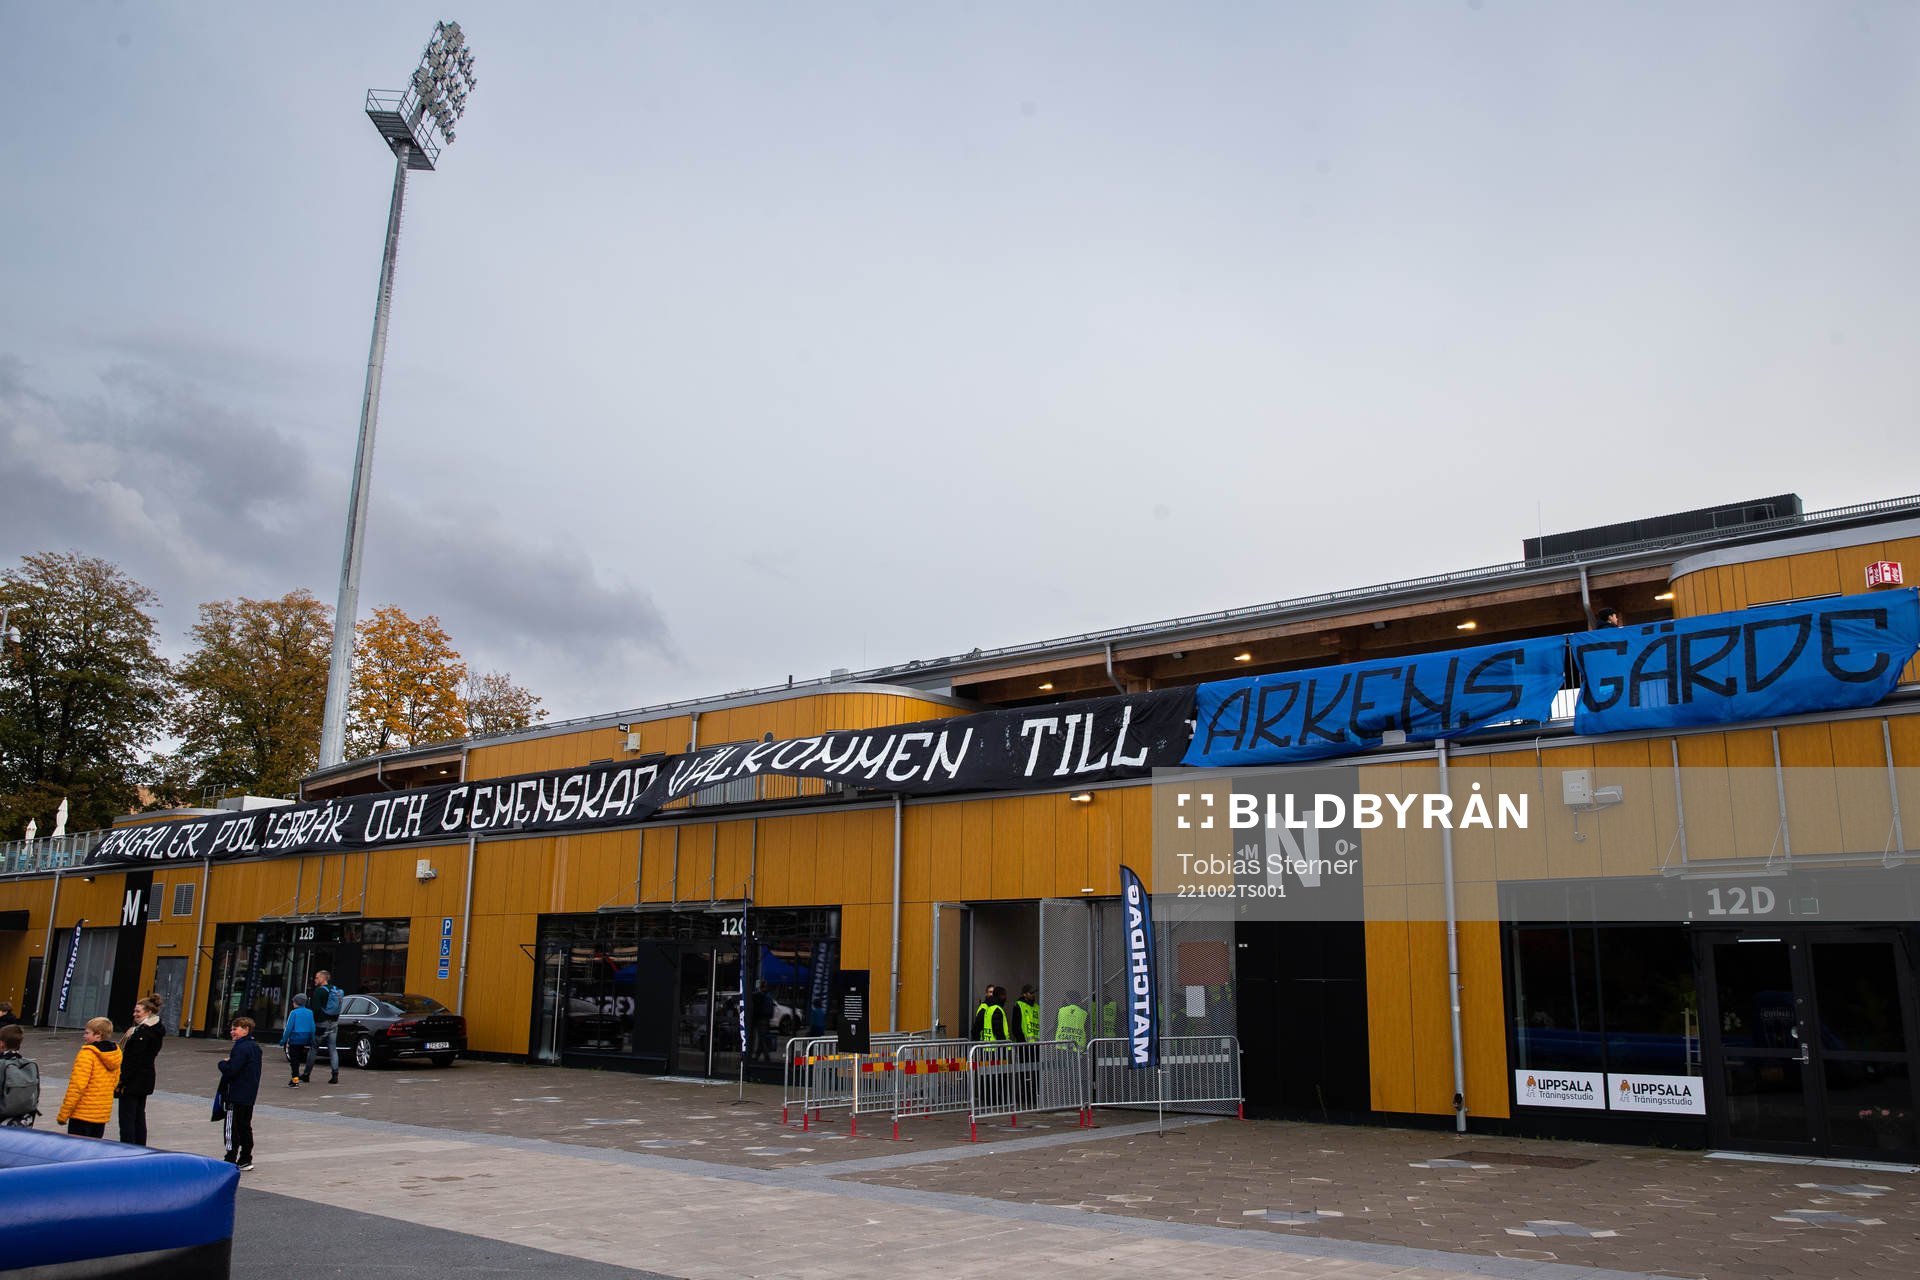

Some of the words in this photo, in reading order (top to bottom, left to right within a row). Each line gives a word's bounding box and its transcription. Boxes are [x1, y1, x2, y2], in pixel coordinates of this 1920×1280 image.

[1576, 608, 1890, 713] GÄRDE
[1202, 648, 1525, 755] ARKENS
[208, 800, 353, 855] POLISBRÅK
[364, 794, 428, 842] OCH
[440, 764, 658, 831] GEMENSKAP
[668, 728, 973, 797] VÄLKOMMEN
[1021, 705, 1149, 777] TILL
[123, 889, 141, 926] M
[1707, 886, 1776, 915] 12D
[299, 926, 315, 940] 12B
[58, 925, 83, 1011] MATCHDAG
[1537, 1079, 1593, 1092] UPPSALA
[1539, 1090, 1594, 1101] Träningsstudio
[1632, 1083, 1692, 1097] UPPSALA
[1633, 1095, 1693, 1106] Träningsstudio
